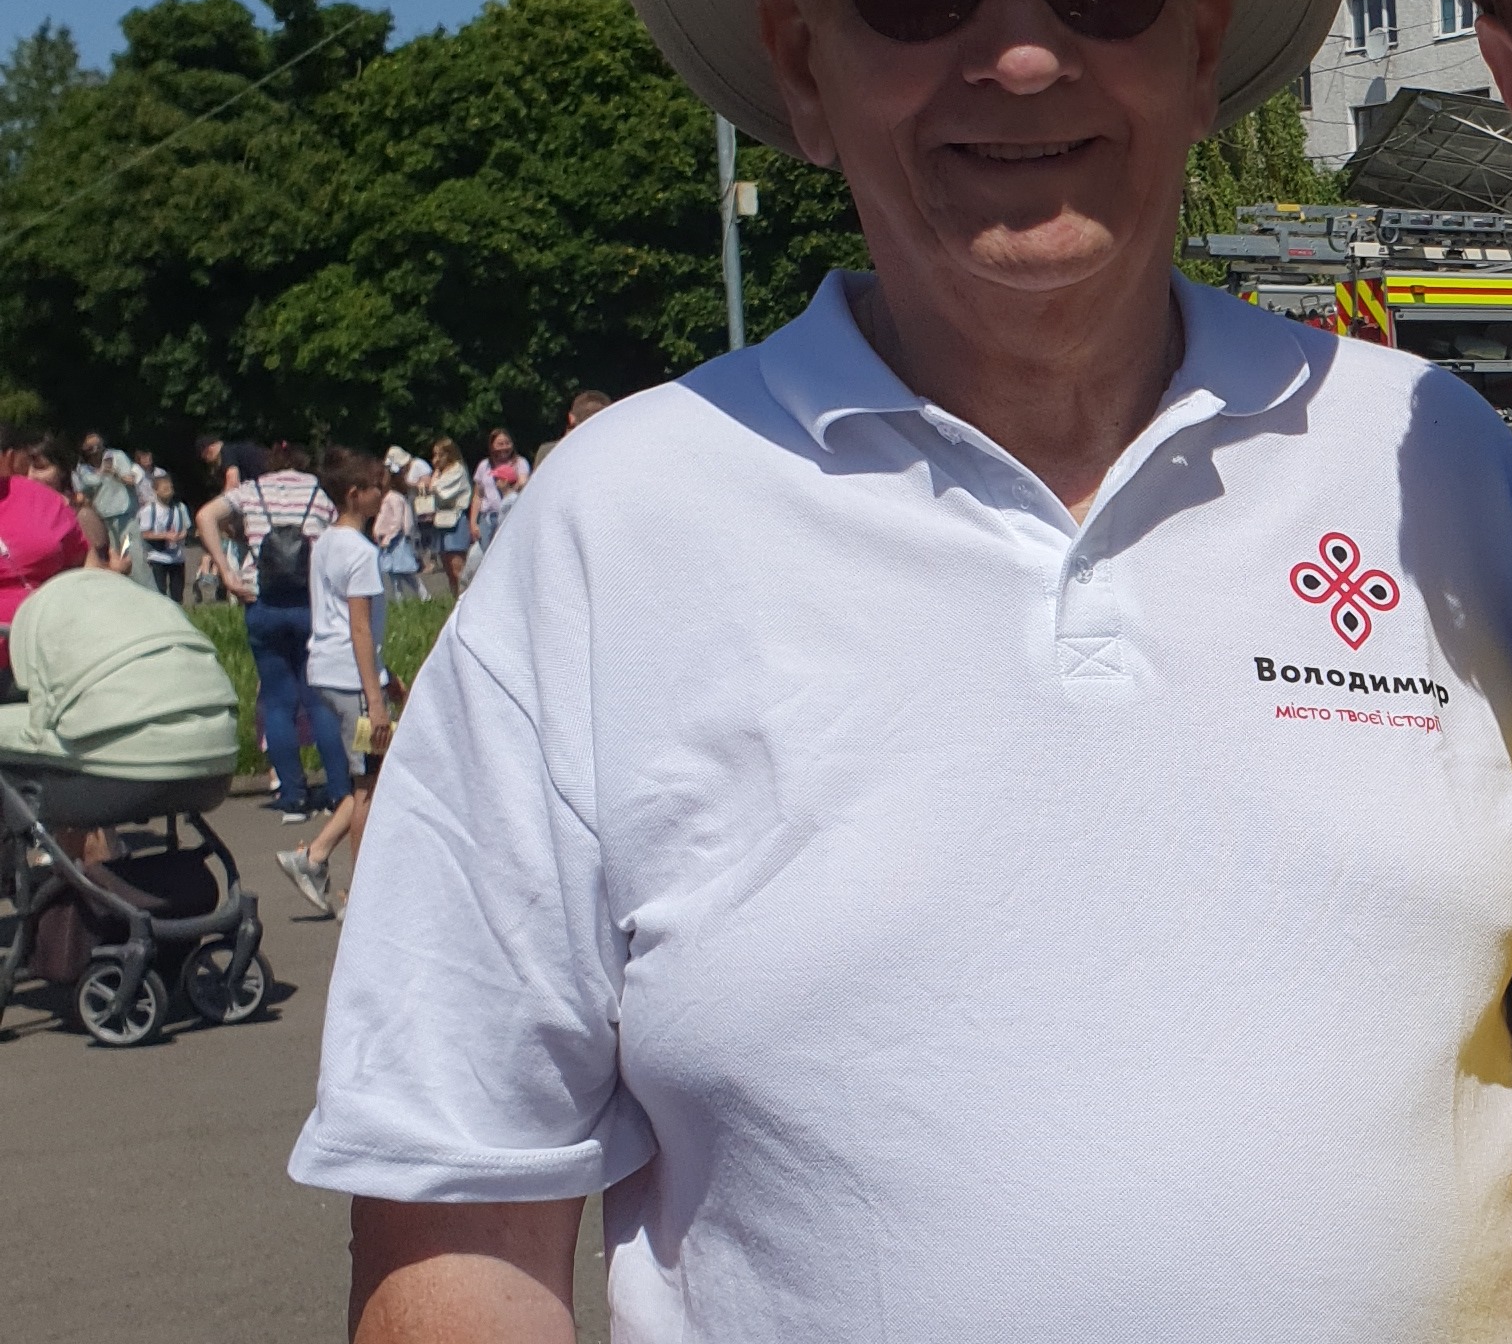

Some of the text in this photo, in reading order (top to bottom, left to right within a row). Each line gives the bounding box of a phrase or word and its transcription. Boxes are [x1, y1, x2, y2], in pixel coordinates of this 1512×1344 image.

[1254, 656, 1450, 708] Володимир
[1275, 702, 1332, 720] місто
[1336, 708, 1385, 726] твоєї
